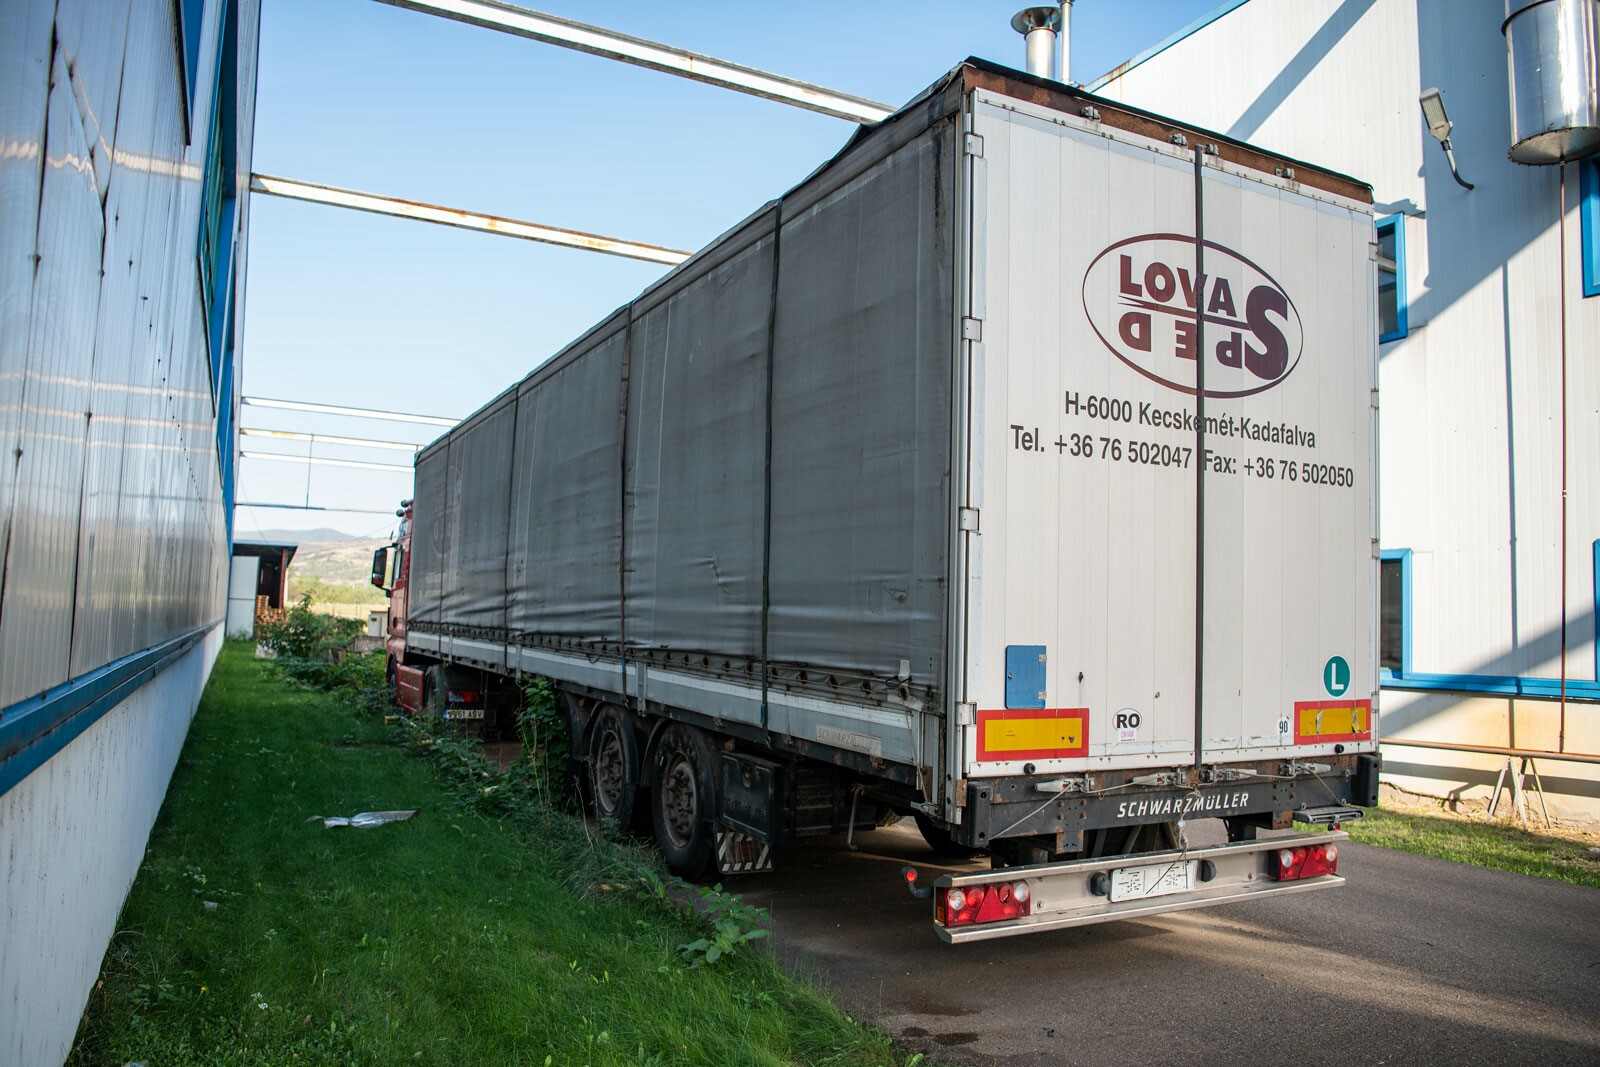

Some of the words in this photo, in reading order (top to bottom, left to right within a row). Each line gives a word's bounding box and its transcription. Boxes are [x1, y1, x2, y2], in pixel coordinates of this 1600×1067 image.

[1120, 254, 1288, 380] LOVAS
[1065, 391, 1132, 423] H-6000
[1139, 401, 1316, 448] Kecskemét-Kadafalva
[1010, 424, 1045, 452] Tel.
[1054, 433, 1093, 458] +36
[1099, 437, 1122, 462] 76
[1128, 441, 1192, 469] 502047
[1203, 449, 1237, 474] Fax:
[1244, 457, 1275, 479] +36
[1279, 460, 1298, 482] 76
[1302, 463, 1354, 488] 502050
[1331, 662, 1345, 690] L
[1116, 713, 1140, 728] RO
[1279, 720, 1288, 734] 90
[1116, 792, 1249, 818] SCHWARZMÜLLER
